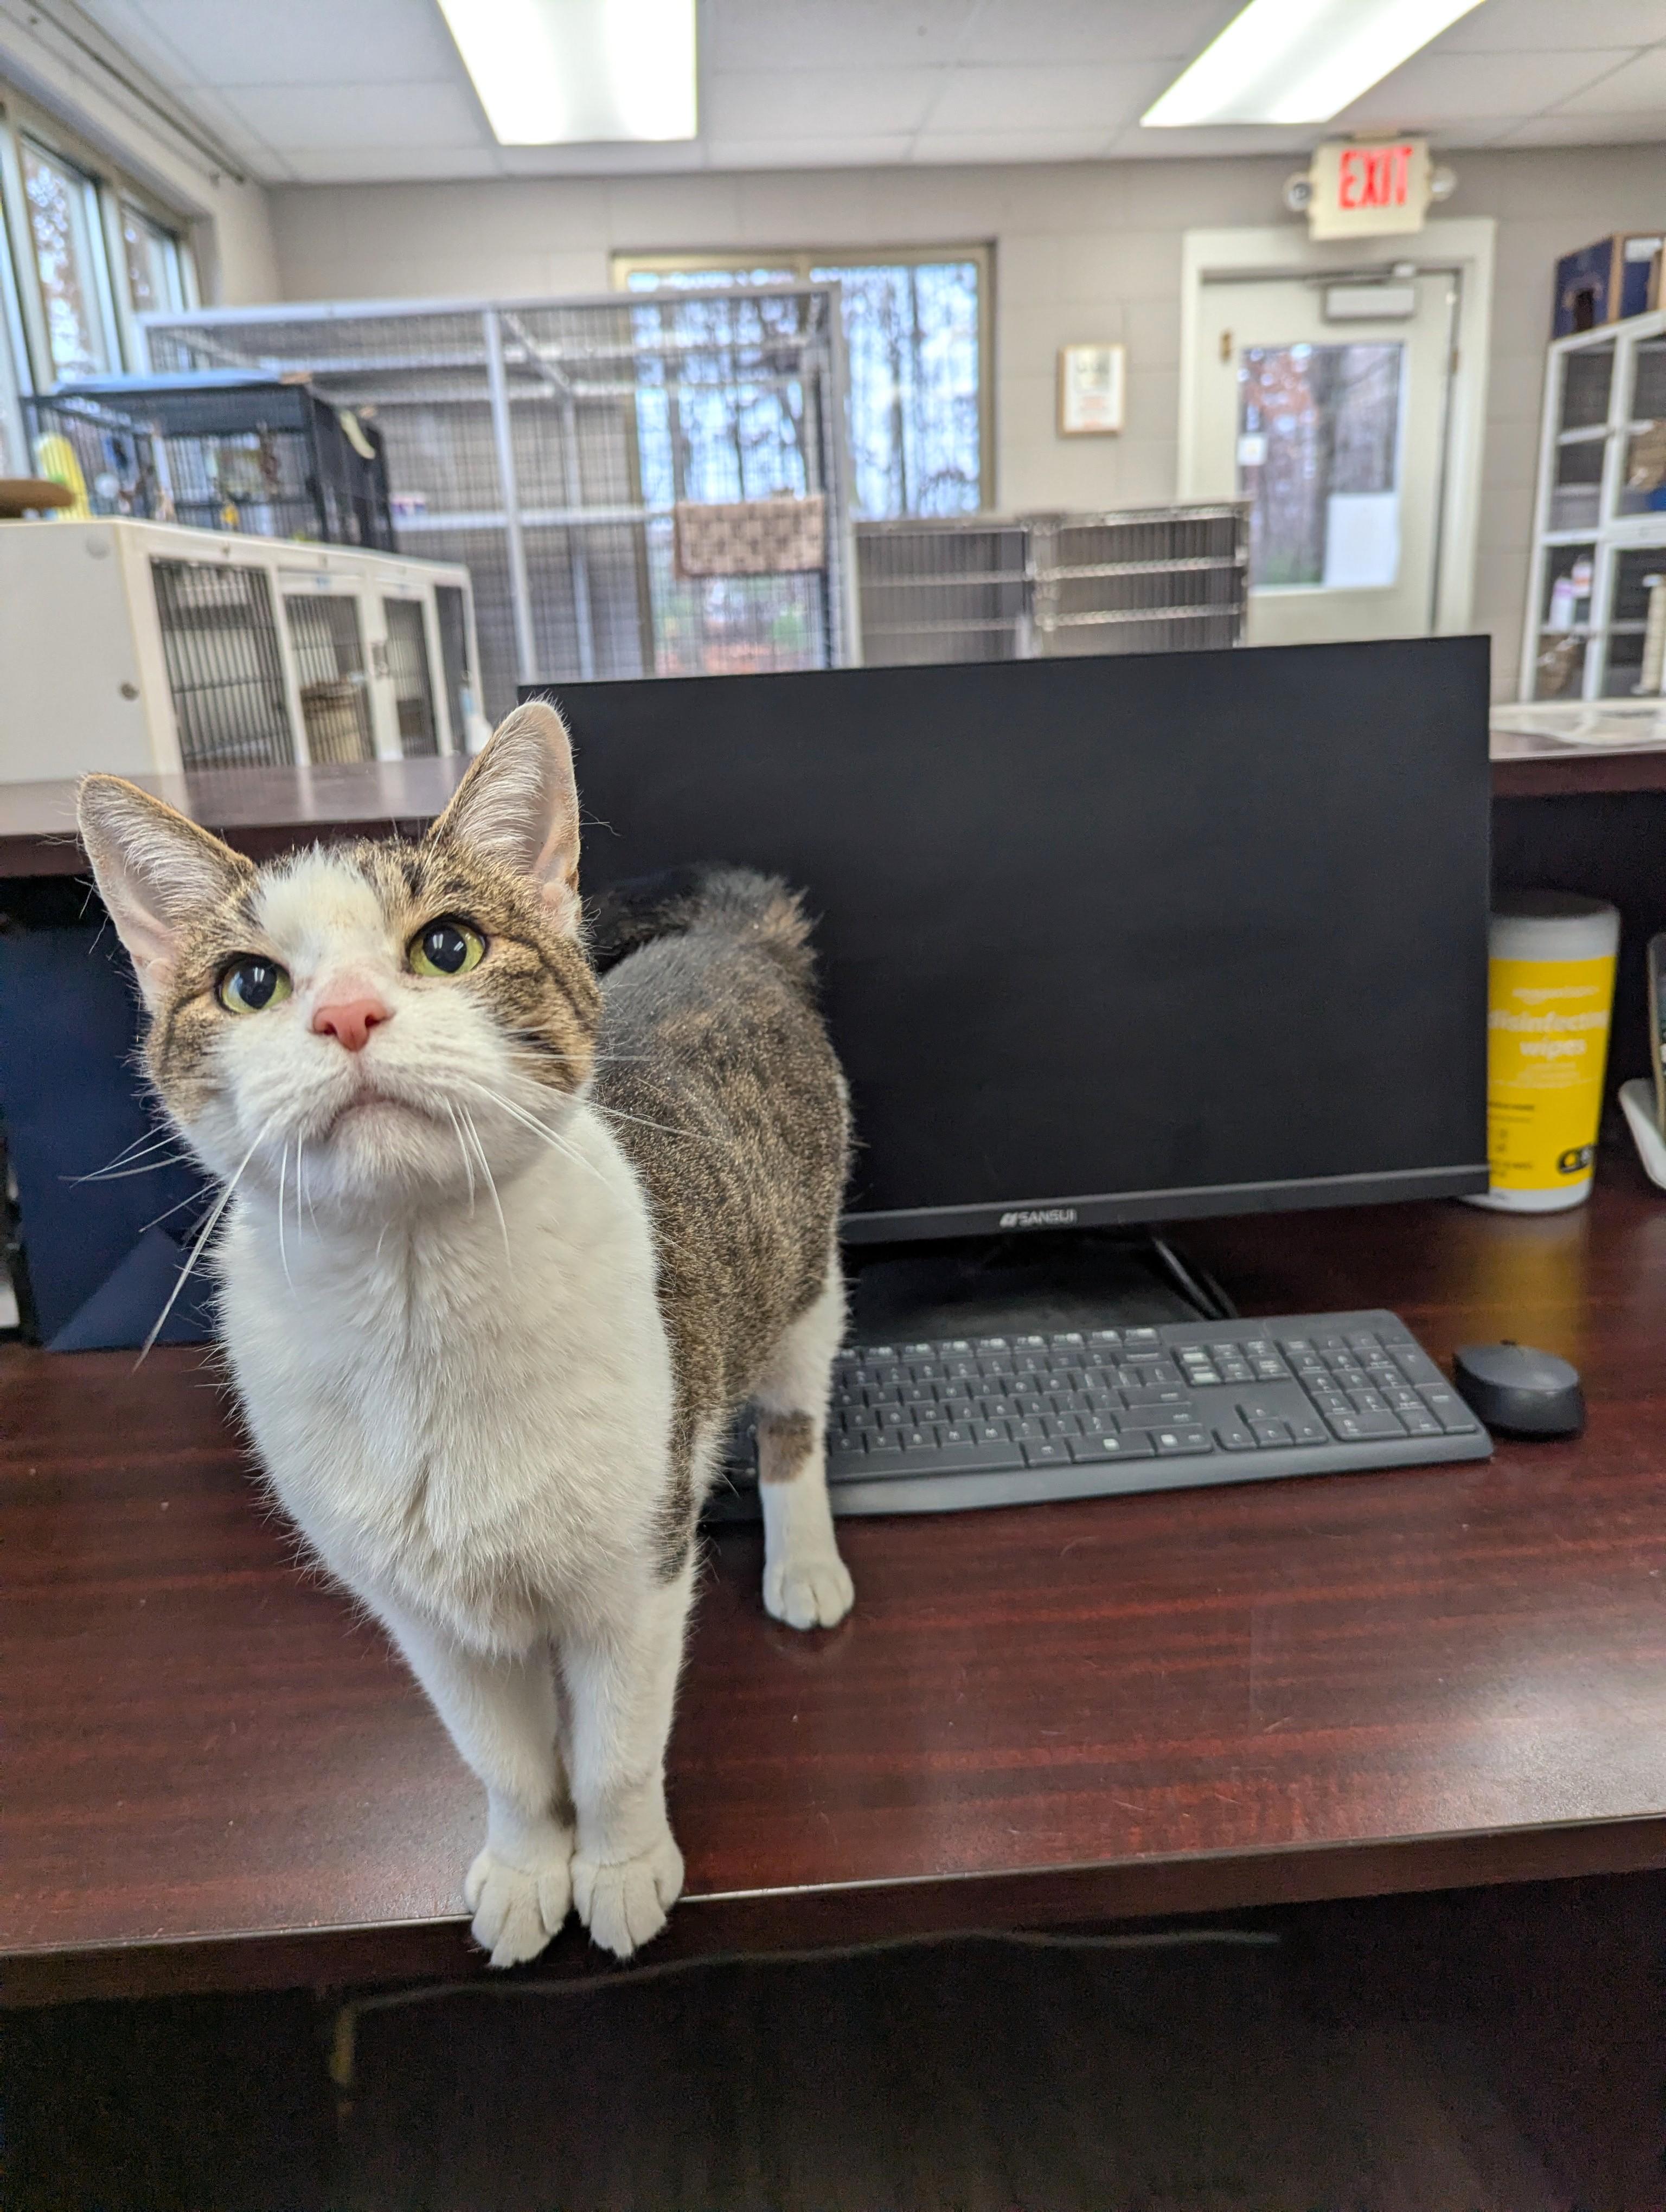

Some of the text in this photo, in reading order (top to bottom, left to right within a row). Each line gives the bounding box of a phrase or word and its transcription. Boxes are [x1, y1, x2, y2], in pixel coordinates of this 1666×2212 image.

[1339, 145, 1413, 210] EXIT
[1520, 1037, 1587, 1060] wipes
[1017, 1208, 1078, 1227] SANSUI
